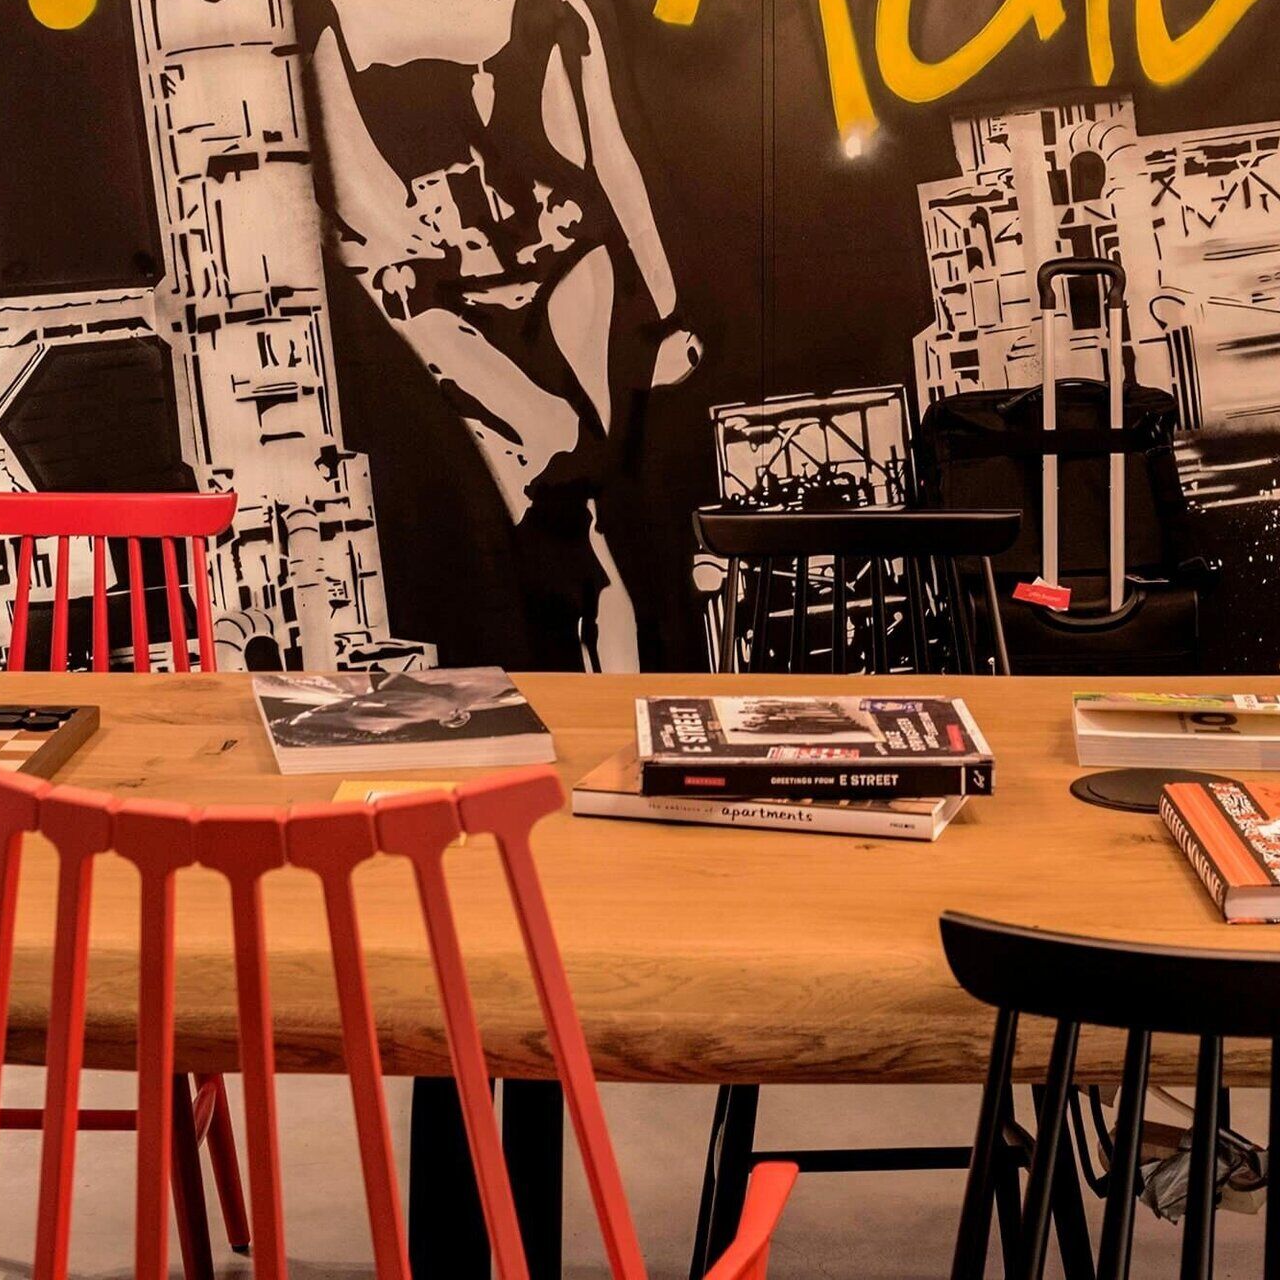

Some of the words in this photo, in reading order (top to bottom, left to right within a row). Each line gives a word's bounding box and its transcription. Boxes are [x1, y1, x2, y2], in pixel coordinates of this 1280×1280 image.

[839, 774, 849, 787] E
[850, 773, 899, 787] STREET
[721, 805, 813, 822] apartments
